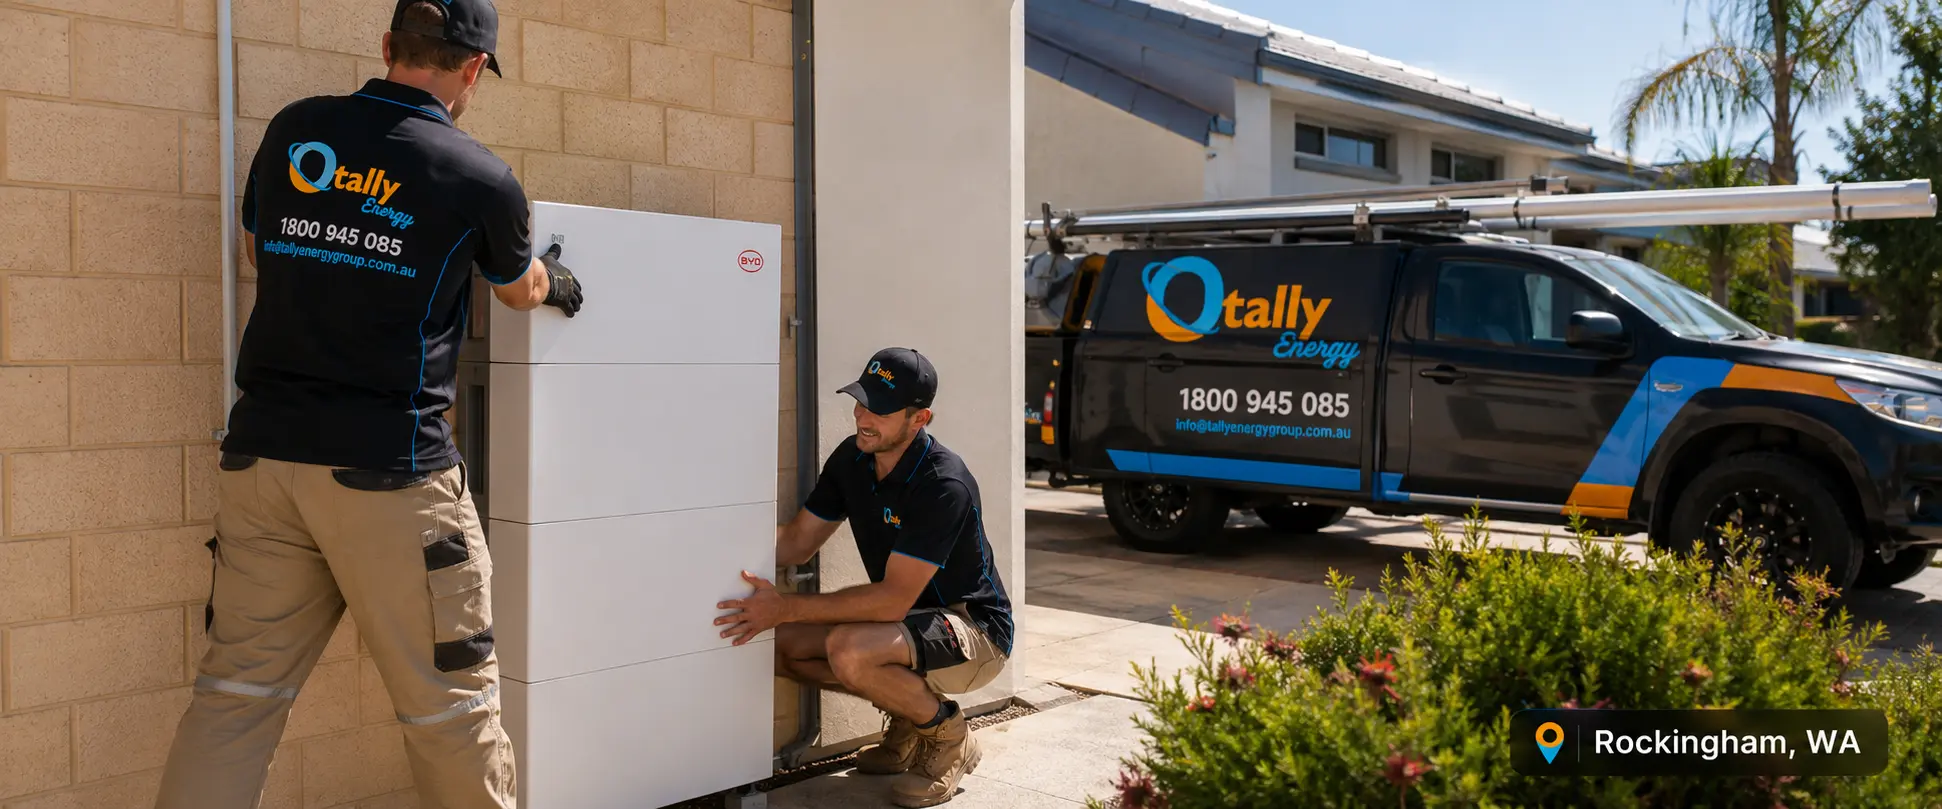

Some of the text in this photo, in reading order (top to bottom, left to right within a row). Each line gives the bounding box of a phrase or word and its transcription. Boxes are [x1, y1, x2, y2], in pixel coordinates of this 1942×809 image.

[360, 197, 415, 230] Energy
[280, 217, 403, 256] 1800 945 085
[1272, 330, 1361, 369] Energy
[1179, 388, 1350, 418] 1800 945 085
[1175, 418, 1351, 439] info@tallyenergygroup.com.au
